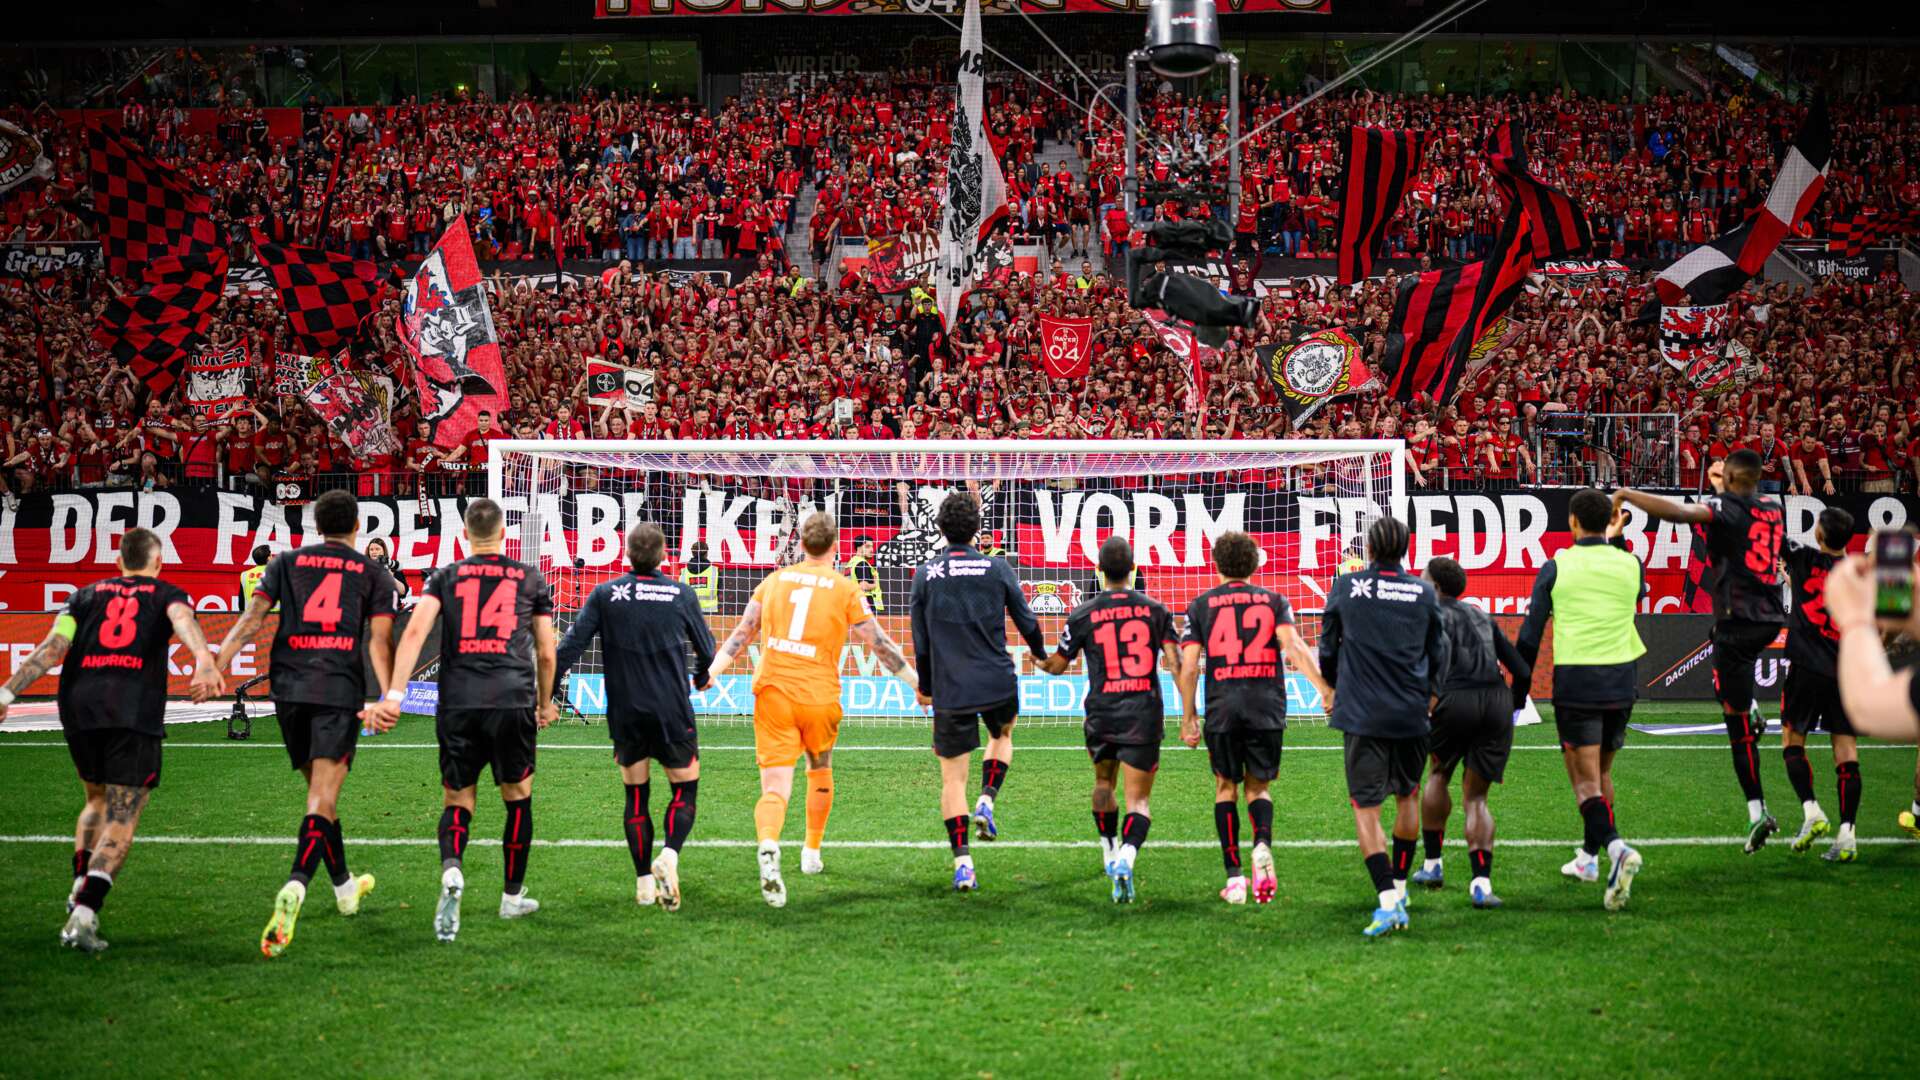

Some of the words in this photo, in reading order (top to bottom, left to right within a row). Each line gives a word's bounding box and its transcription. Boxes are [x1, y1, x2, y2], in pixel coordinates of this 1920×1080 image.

[1049, 345, 1080, 361] 04
[48, 490, 183, 564] DER
[296, 555, 344, 570] BAYER
[345, 559, 364, 574] 04
[457, 565, 503, 578] BAYER
[506, 567, 525, 580] 04
[949, 560, 991, 569] Barmenia
[949, 567, 987, 577] Gothaer
[635, 582, 680, 596] Barmenia
[635, 591, 674, 602] Gothaer
[303, 572, 343, 632] 4
[1208, 592, 1251, 608] BAYER
[1252, 593, 1270, 604] 04
[455, 578, 518, 641] 14
[788, 586, 814, 641] 1
[1090, 608, 1133, 623] BAYER
[1134, 606, 1151, 618] 04
[99, 596, 140, 649] 8
[1207, 604, 1277, 664] 42
[288, 635, 354, 651] QUANSAH
[459, 639, 507, 654] SCHICK
[1094, 620, 1154, 679] 13
[81, 653, 143, 669] ANDRICH
[1665, 643, 1714, 687] DACHTECH
[1102, 679, 1152, 693] ARTHUR
